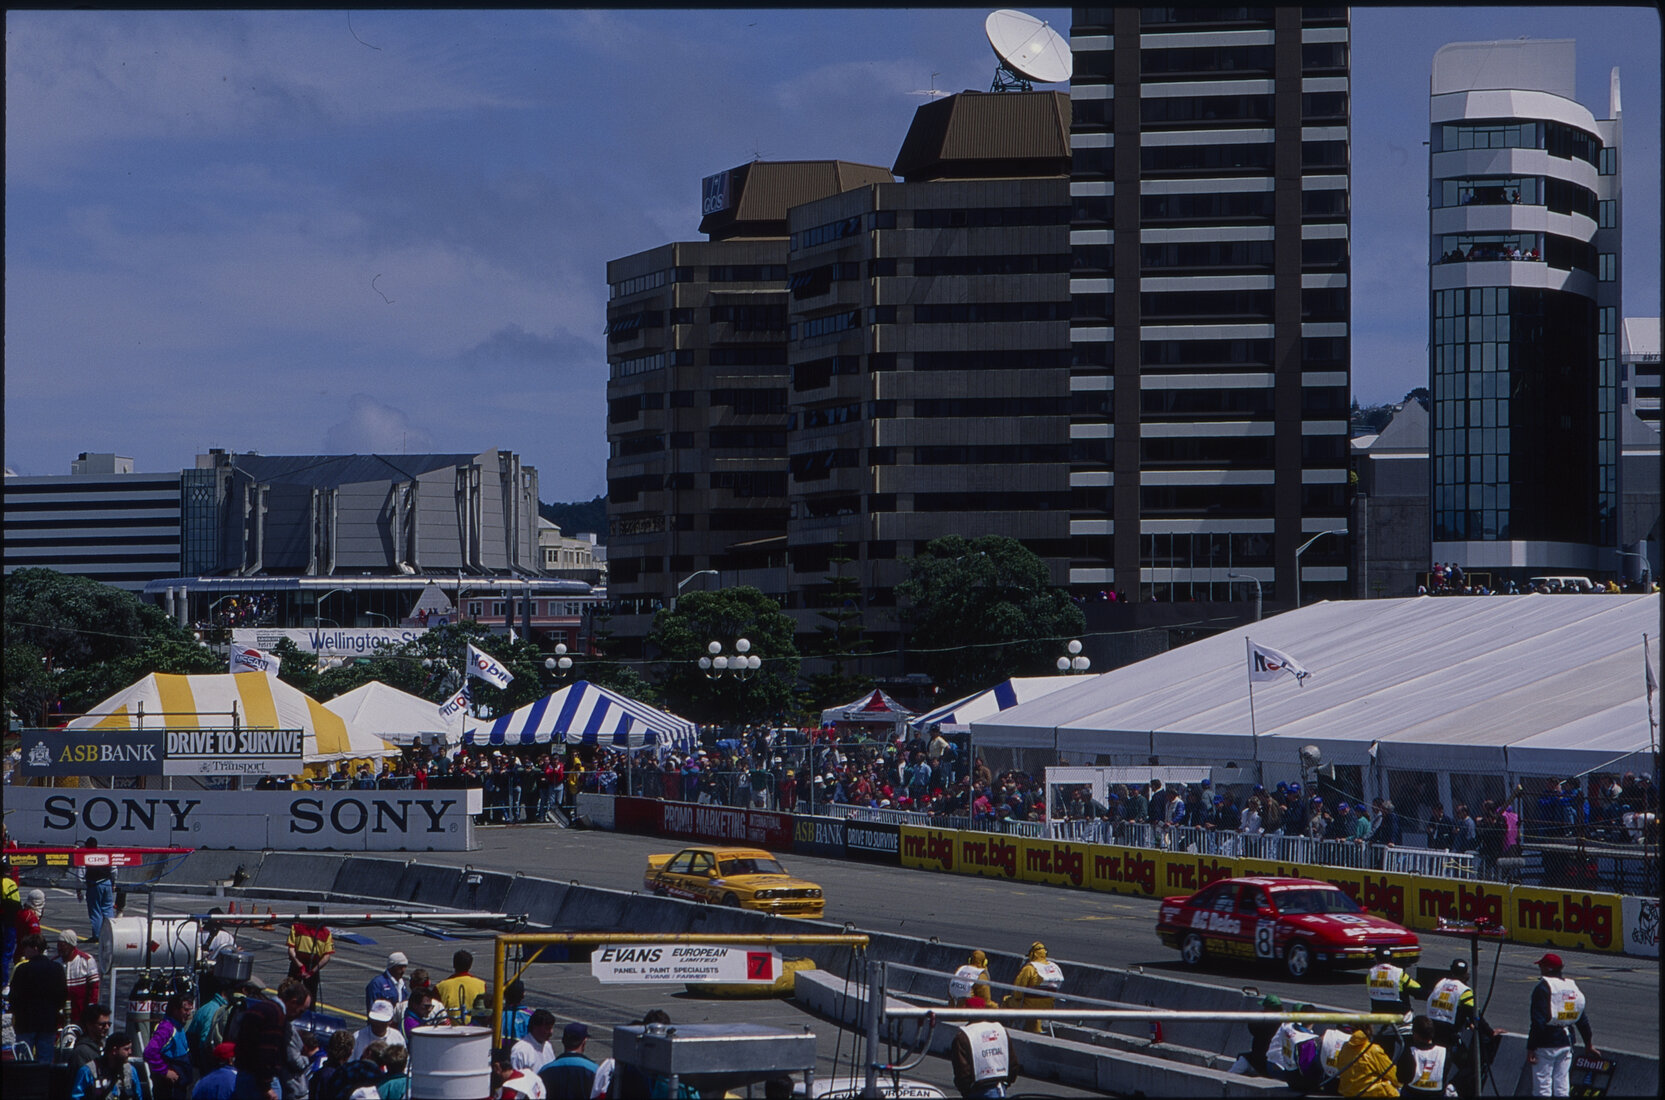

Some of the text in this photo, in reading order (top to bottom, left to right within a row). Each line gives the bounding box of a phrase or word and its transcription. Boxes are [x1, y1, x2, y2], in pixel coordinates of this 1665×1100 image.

[235, 654, 268, 670] NISSAN
[471, 650, 507, 682] Mobil
[167, 731, 301, 753] DRIVE TO SURVIVE
[213, 761, 265, 773] Transport
[43, 795, 201, 831] SONY
[289, 798, 457, 834] SONY
[664, 805, 747, 840] PROMO MARKETING
[847, 828, 899, 849] DRIVE TO SURVIVE
[904, 831, 953, 870] mr.big
[962, 837, 1017, 877] mr.big
[1026, 844, 1084, 886] mr.big
[1095, 851, 1156, 894] mr.big
[1191, 910, 1210, 930] AC
[1208, 911, 1242, 935] Delco
[1419, 884, 1503, 931] mr.big
[1518, 894, 1612, 948] mr.big
[600, 948, 728, 963] EVANS EUROPEAN
[1259, 928, 1270, 956] 8
[751, 956, 767, 976] 7
[981, 1048, 1004, 1058] OFFICIAL
[1576, 1057, 1604, 1070] Shell
